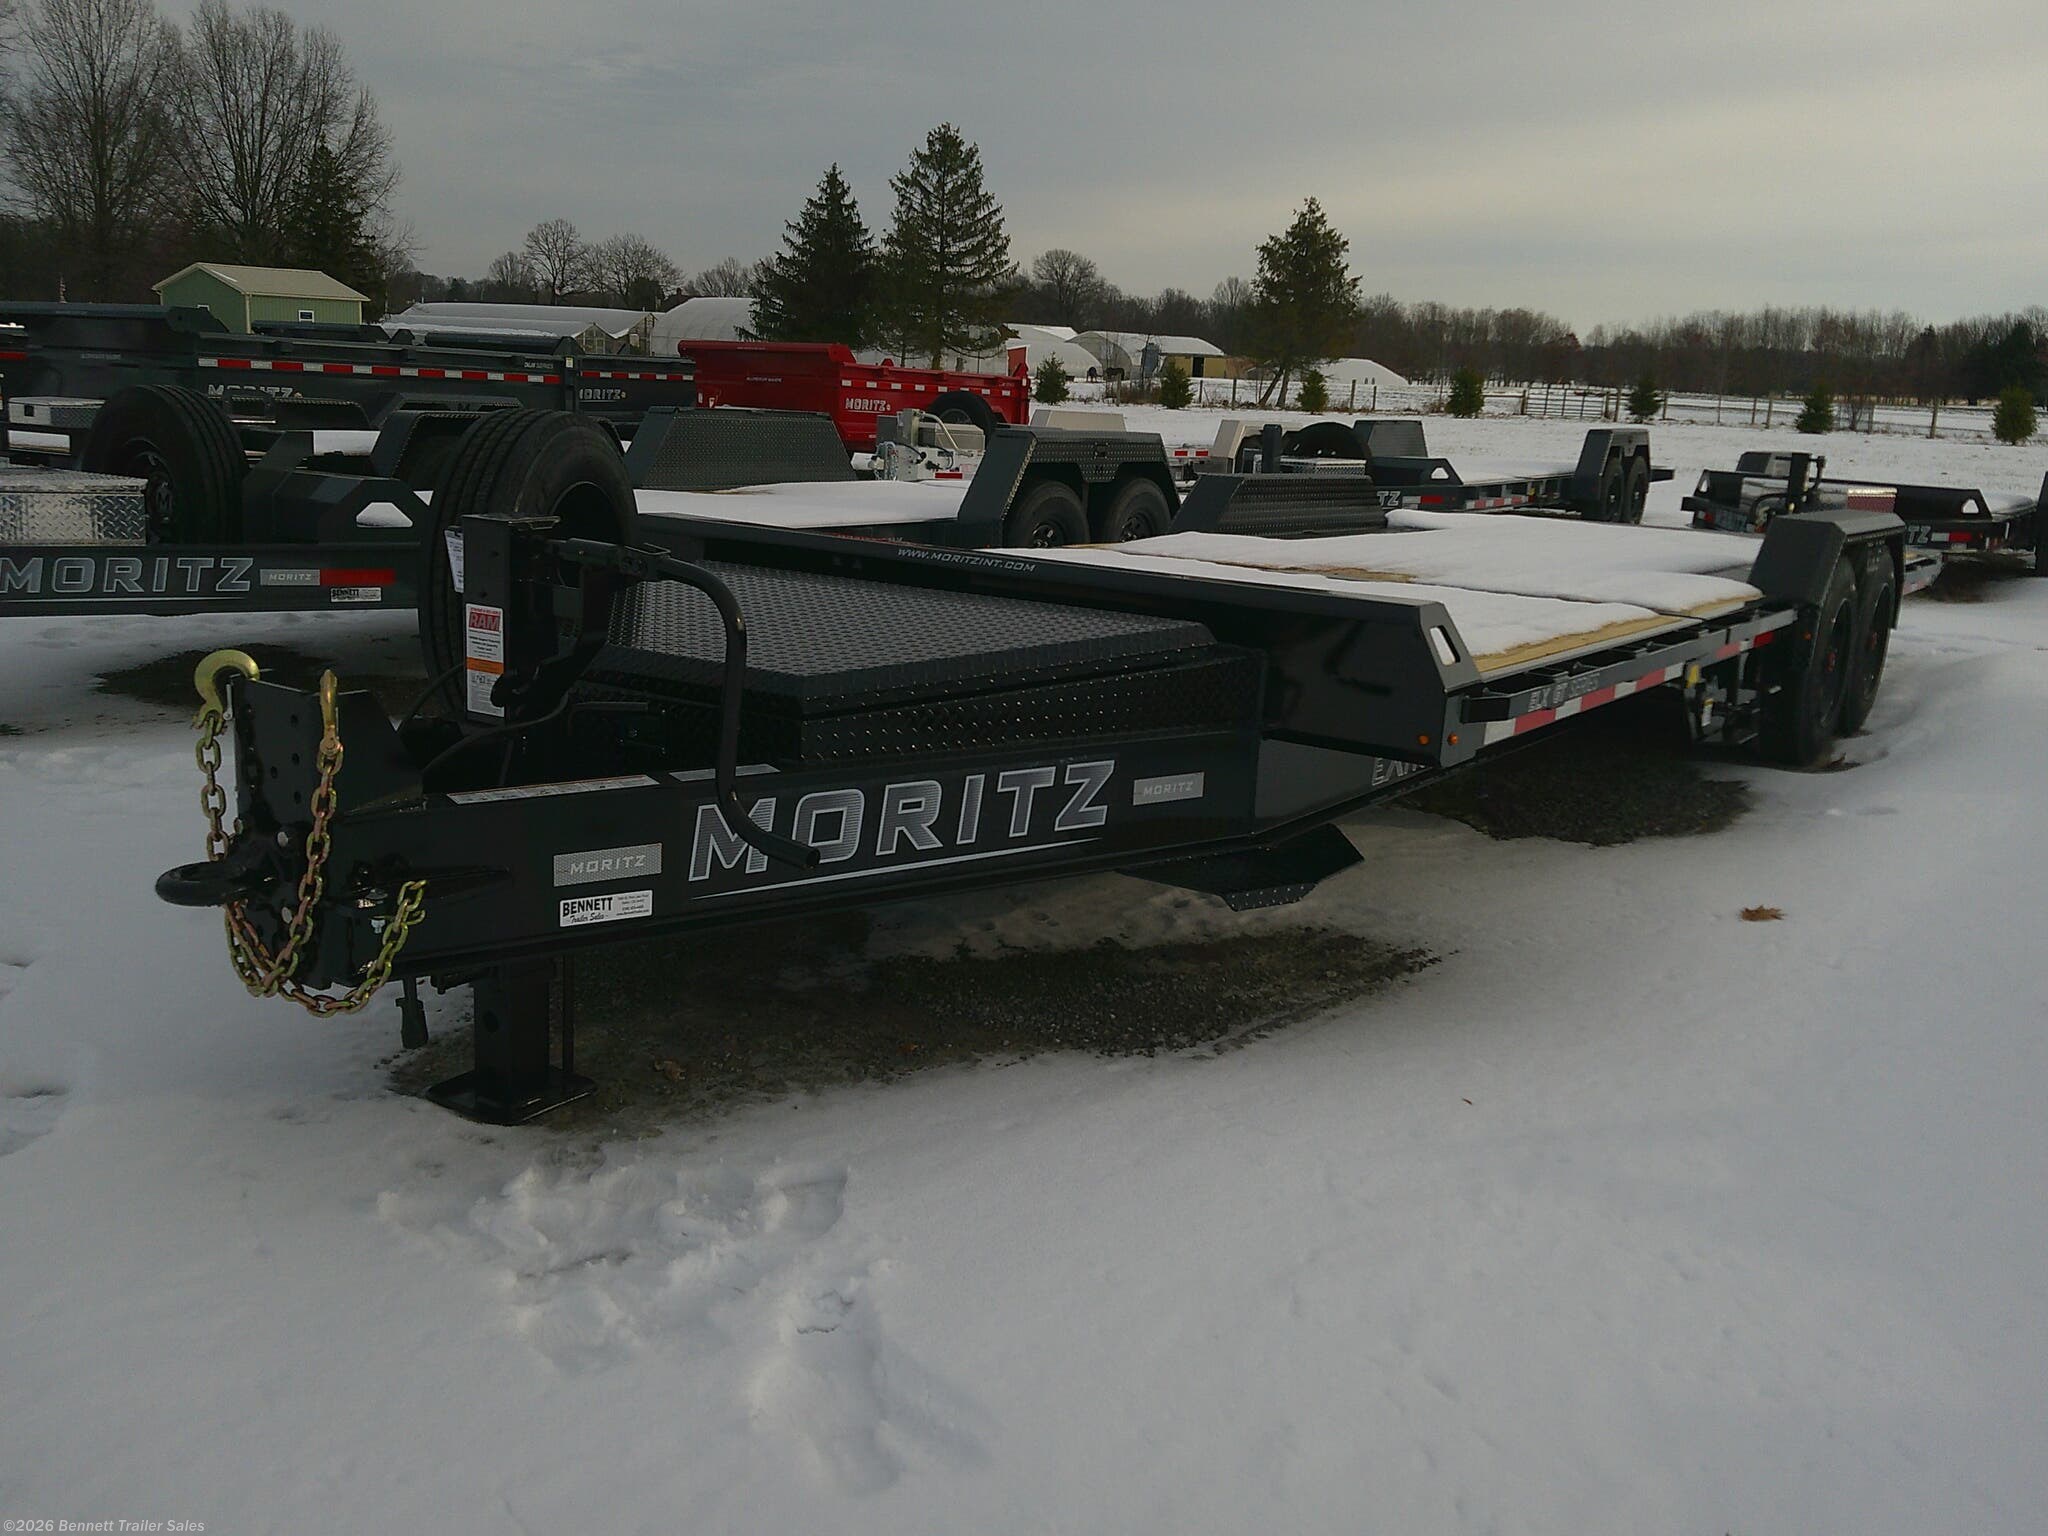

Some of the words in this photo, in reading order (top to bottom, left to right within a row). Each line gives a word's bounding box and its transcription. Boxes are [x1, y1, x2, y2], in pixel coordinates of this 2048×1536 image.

[578, 388, 620, 400] ORITZ
[845, 397, 887, 411] MORITZ
[897, 548, 1036, 572] WWW.MORITZINT.COM
[0, 557, 254, 593] MORITZ
[269, 573, 312, 582] MORITZ
[470, 613, 499, 631] RAM
[1143, 780, 1194, 798] MORITZ
[688, 760, 1116, 882] MORITZ
[570, 854, 646, 876] MORITZ
[562, 897, 613, 917] BENNETT
